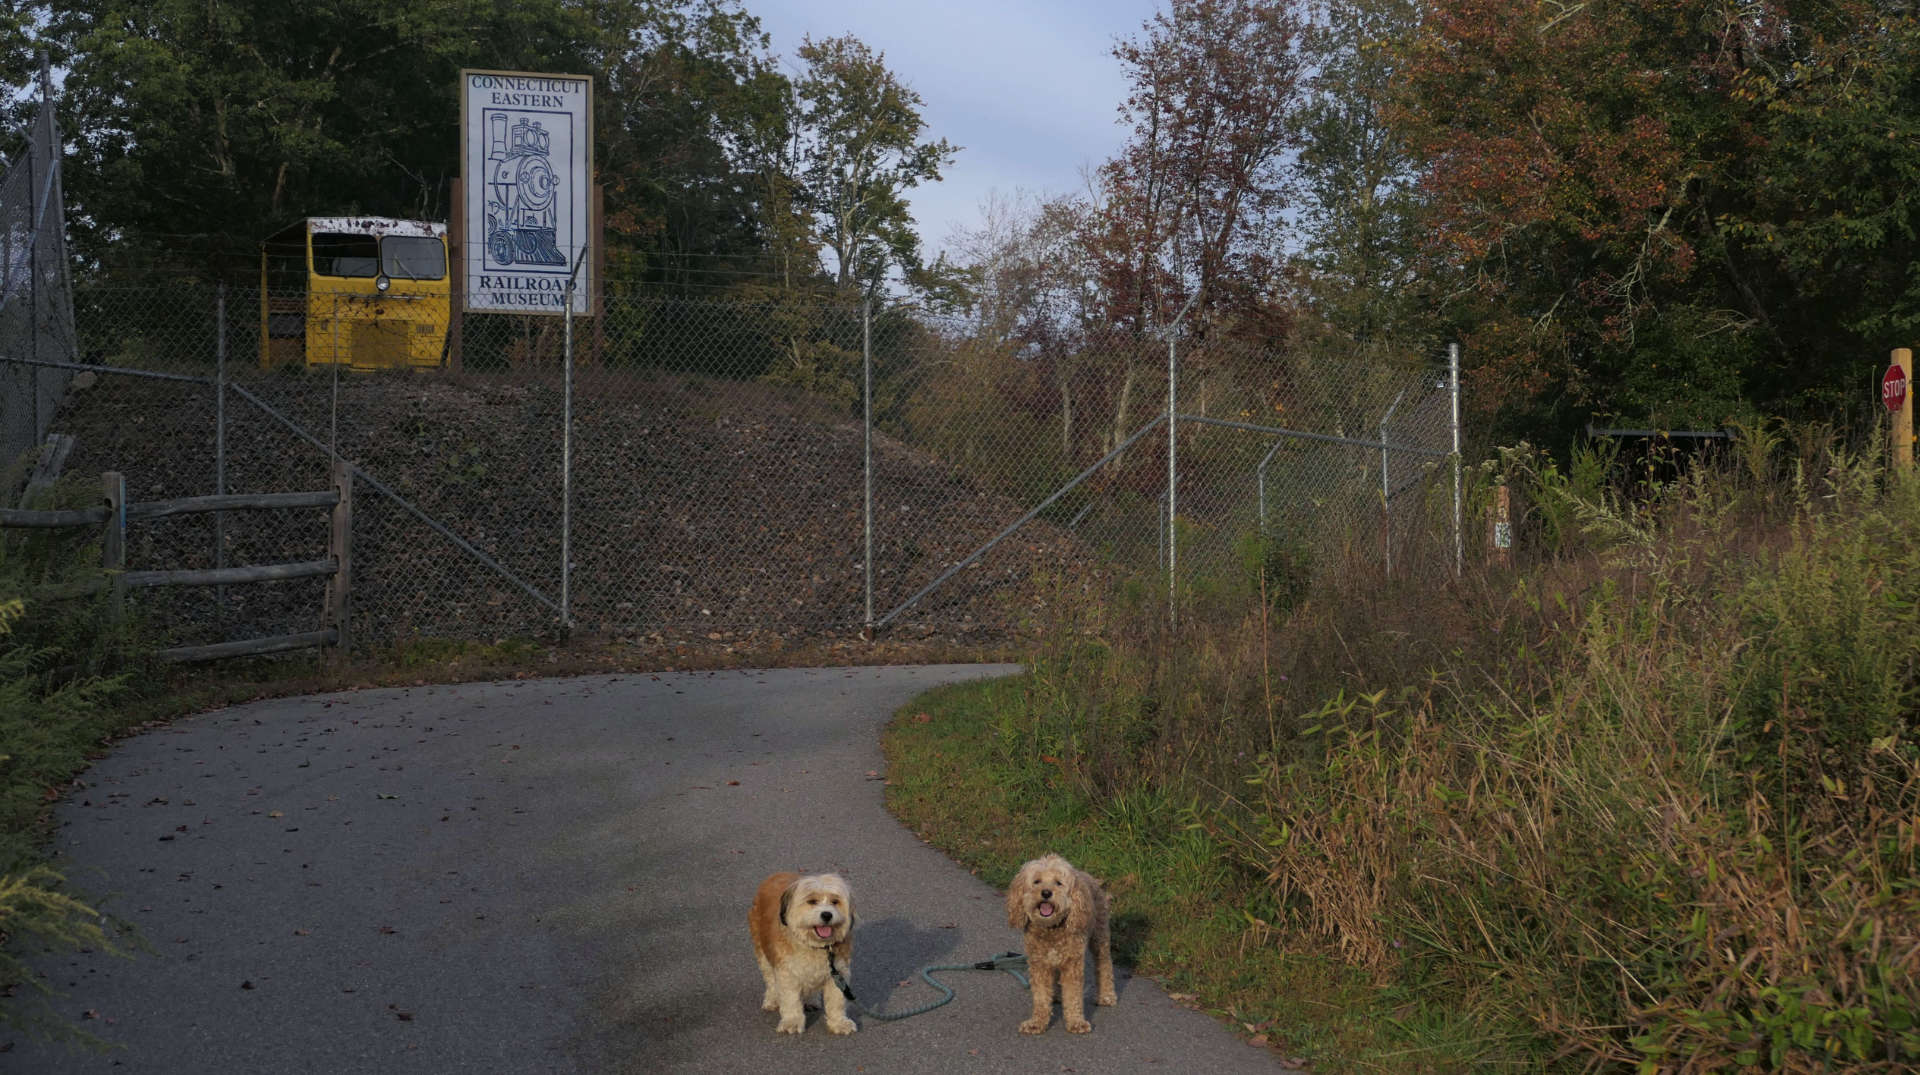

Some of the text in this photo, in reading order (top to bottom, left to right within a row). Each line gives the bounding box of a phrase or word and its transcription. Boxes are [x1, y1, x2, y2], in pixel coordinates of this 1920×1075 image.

[472, 75, 581, 93] CONNECTICUT
[491, 92, 563, 107] EASTERN
[490, 292, 566, 307] MUSEUM
[1883, 378, 1905, 399] STOP
